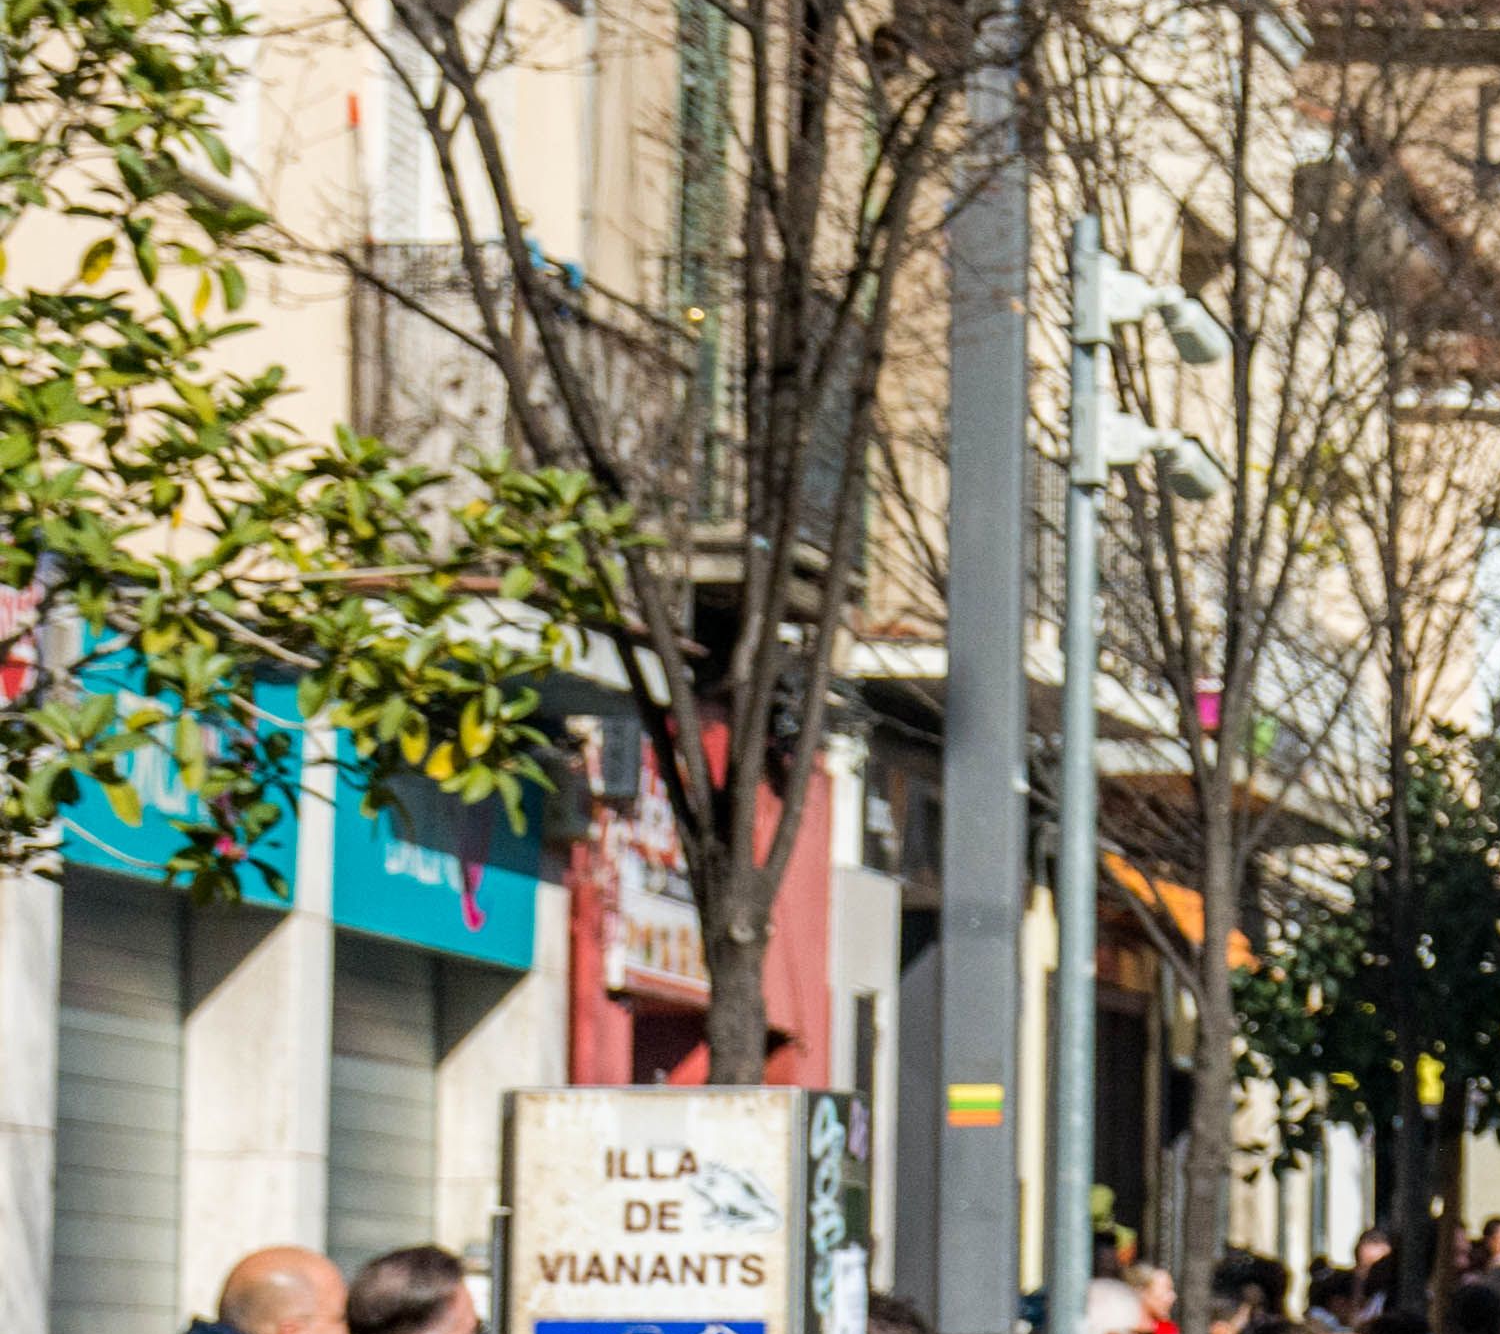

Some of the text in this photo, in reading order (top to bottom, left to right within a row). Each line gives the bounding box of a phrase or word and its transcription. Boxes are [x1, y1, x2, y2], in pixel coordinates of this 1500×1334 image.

[604, 1147, 700, 1180] ILLA
[623, 1198, 682, 1234] DE
[537, 1252, 767, 1287] VIANANTS
